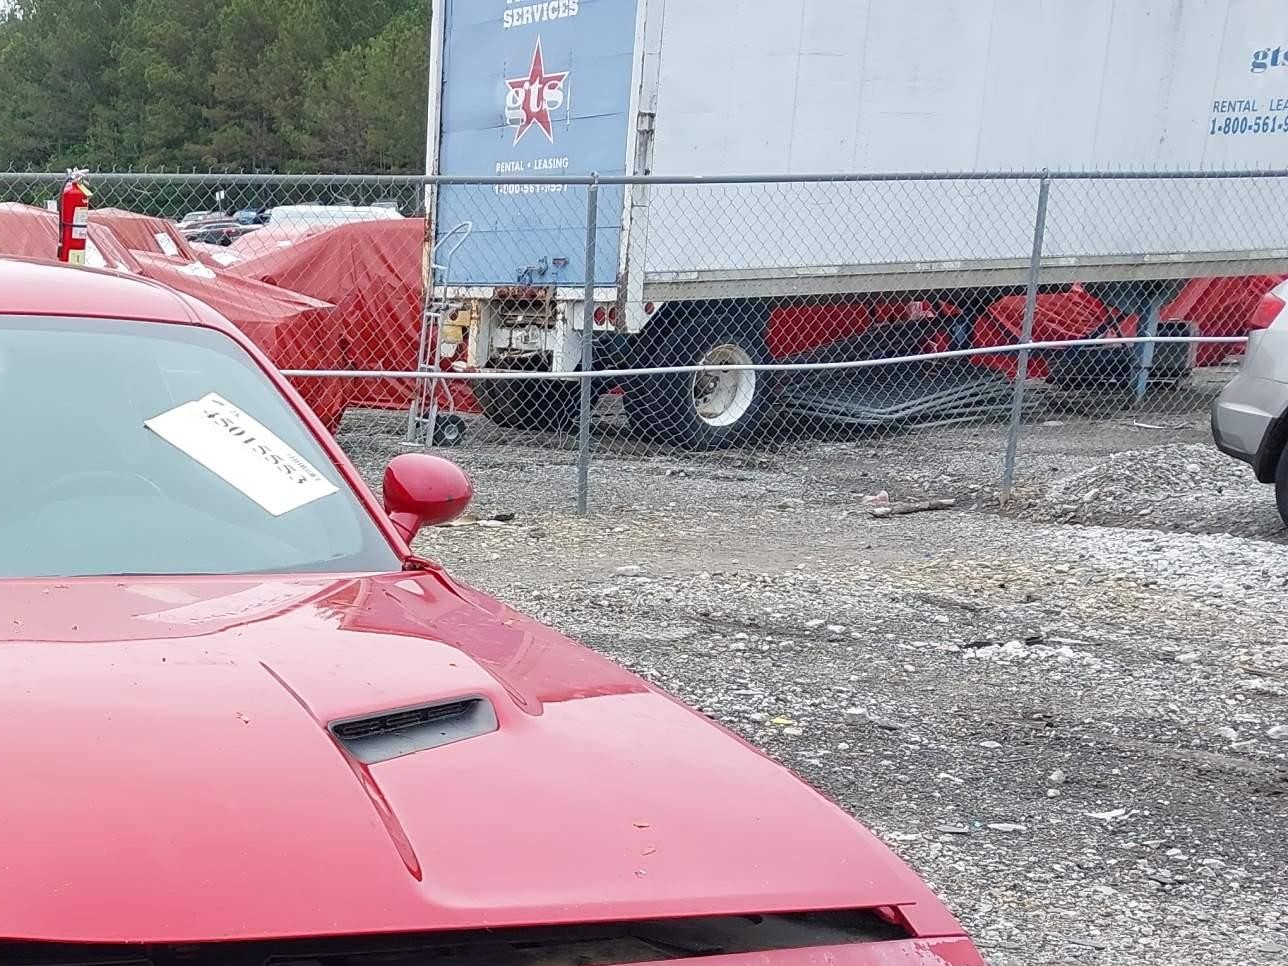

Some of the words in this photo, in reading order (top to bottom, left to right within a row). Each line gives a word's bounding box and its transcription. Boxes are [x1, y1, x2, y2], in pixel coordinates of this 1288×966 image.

[503, 0, 579, 28] SERVICES
[505, 76, 564, 128] gts
[1212, 99, 1258, 113] RENTAL
[495, 160, 524, 174] RENTAL
[533, 156, 569, 170] LEASING
[202, 409, 309, 484] 45015553
